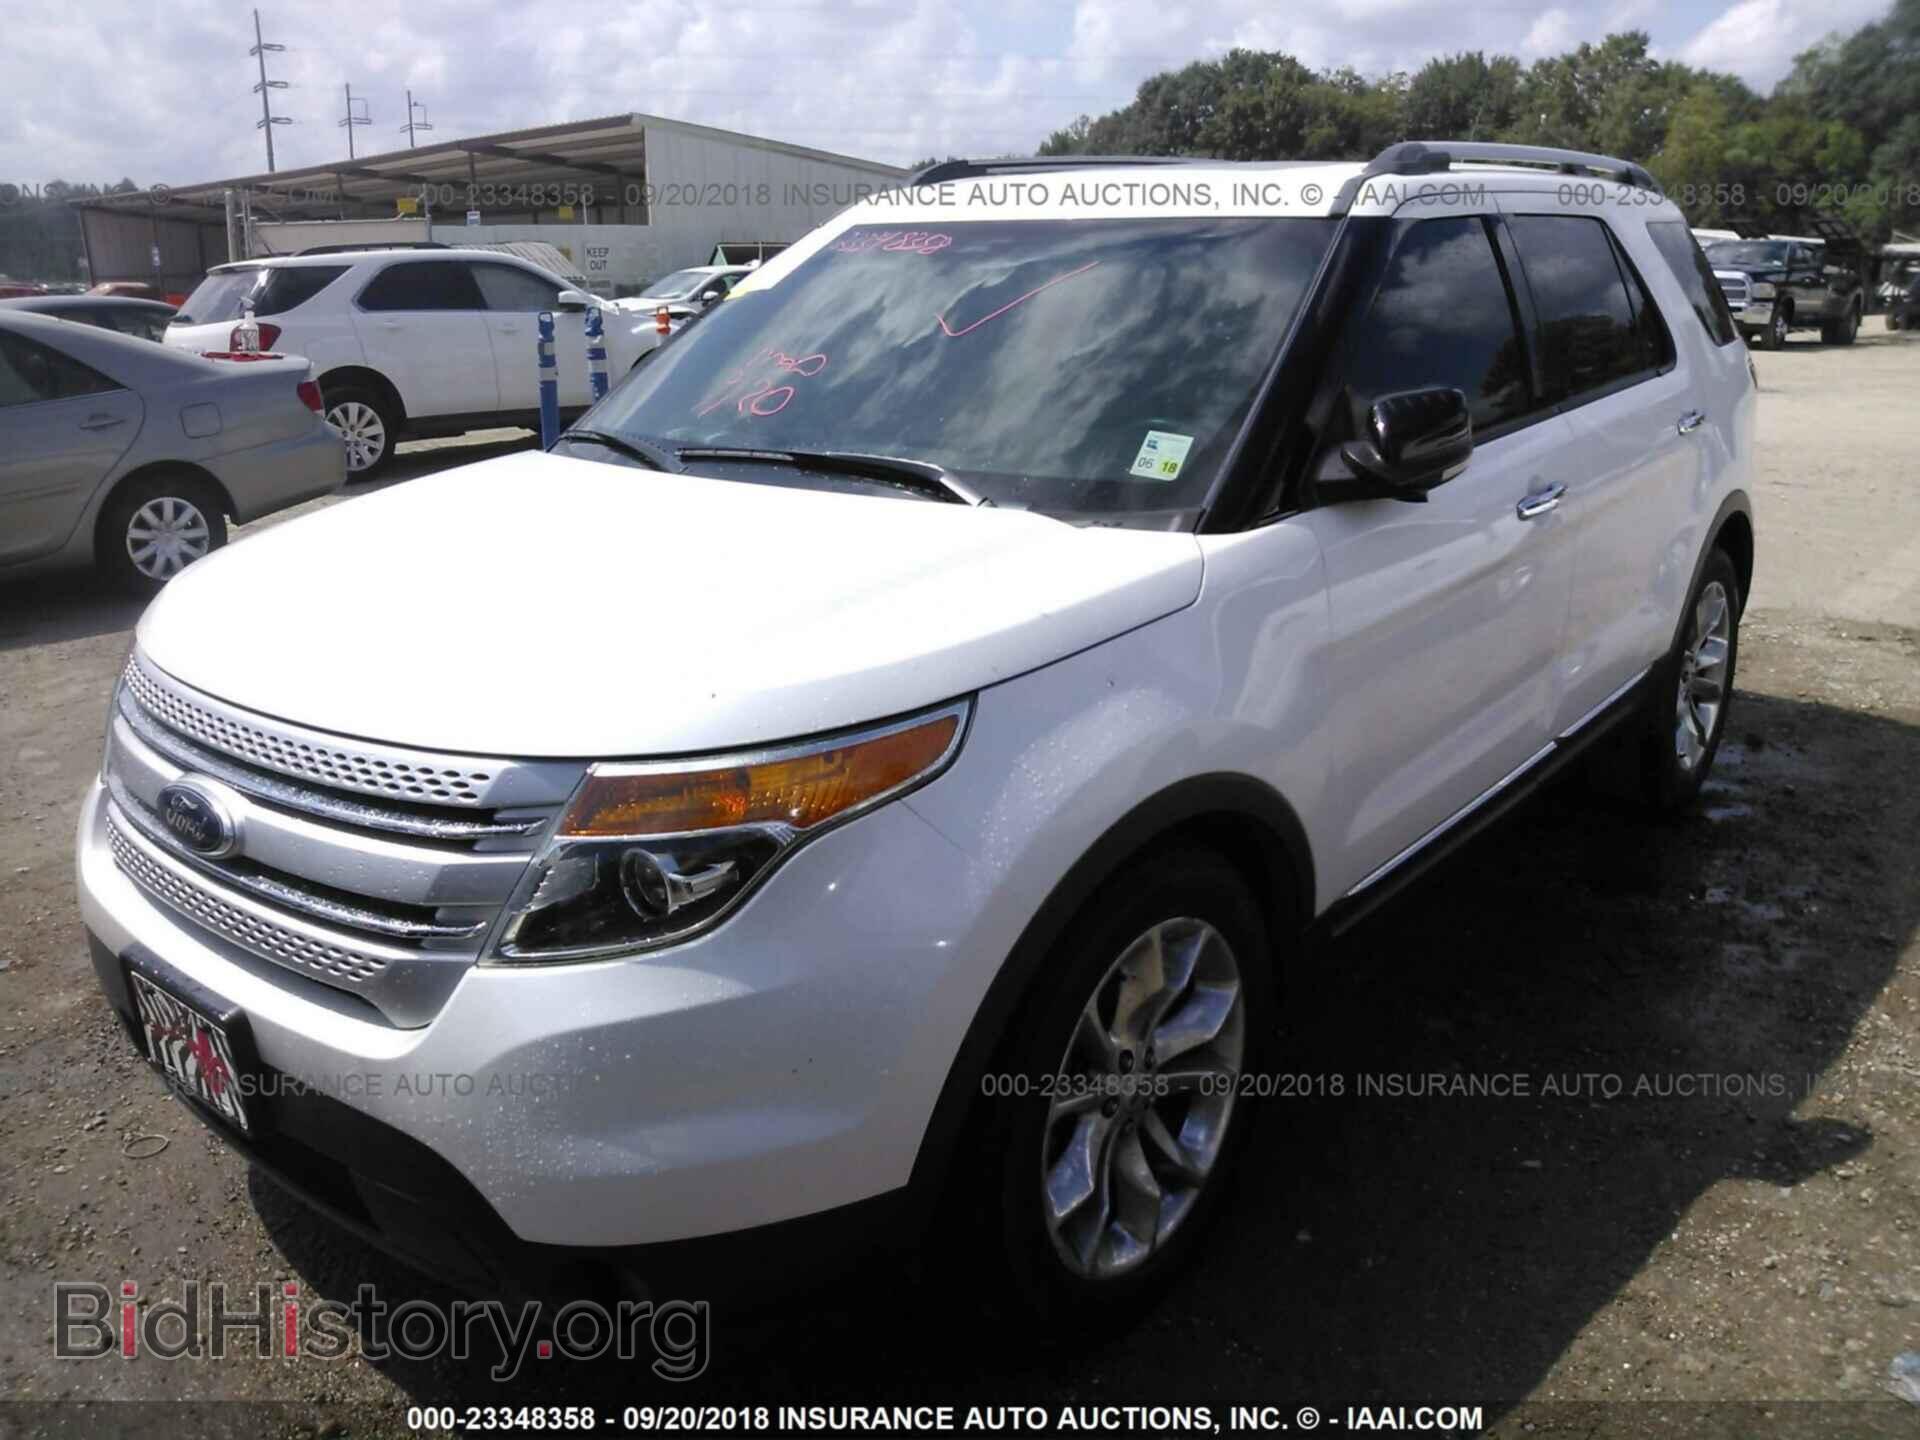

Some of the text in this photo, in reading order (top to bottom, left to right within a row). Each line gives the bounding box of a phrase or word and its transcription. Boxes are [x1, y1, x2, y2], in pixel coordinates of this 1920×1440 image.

[586, 247, 609, 258] KEEP
[590, 260, 607, 271] OUT
[1161, 460, 1178, 474] 18
